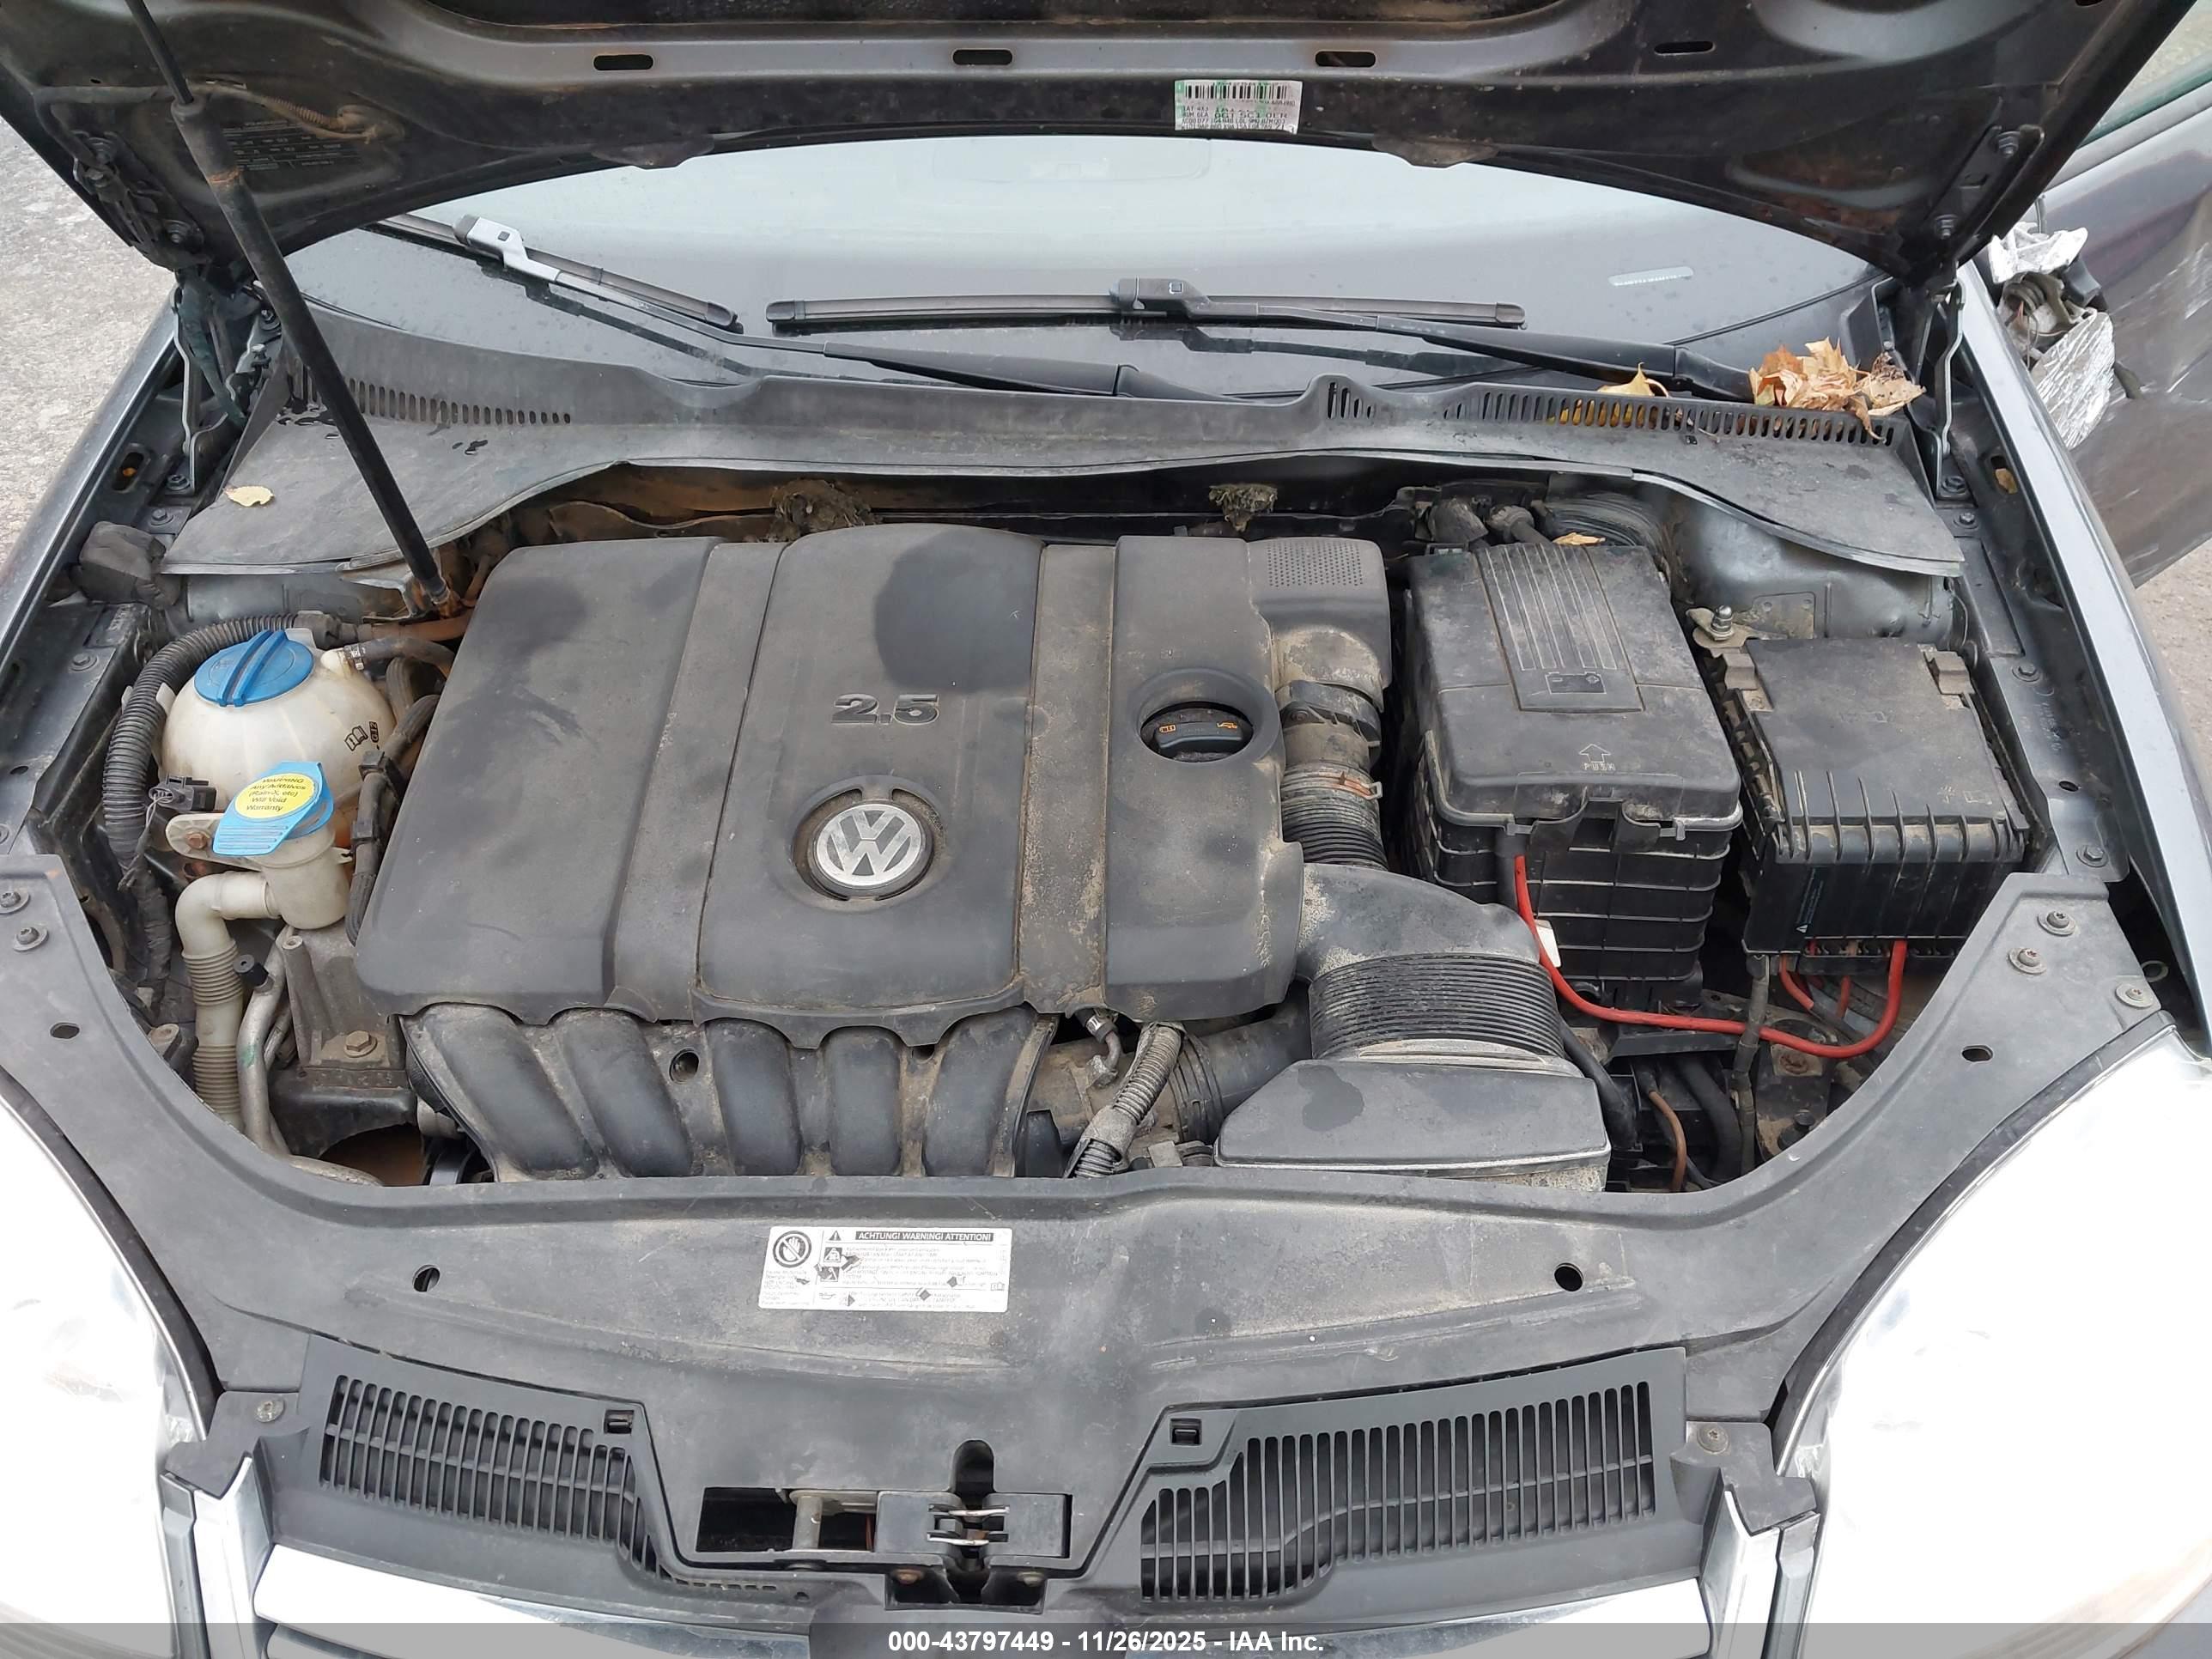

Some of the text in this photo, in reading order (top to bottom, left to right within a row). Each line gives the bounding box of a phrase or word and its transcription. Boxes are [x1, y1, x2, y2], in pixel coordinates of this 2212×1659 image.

[830, 693, 940, 726] 2.5
[858, 1231, 992, 1242] ACHTUNG! WARNING! ATTENTION!
